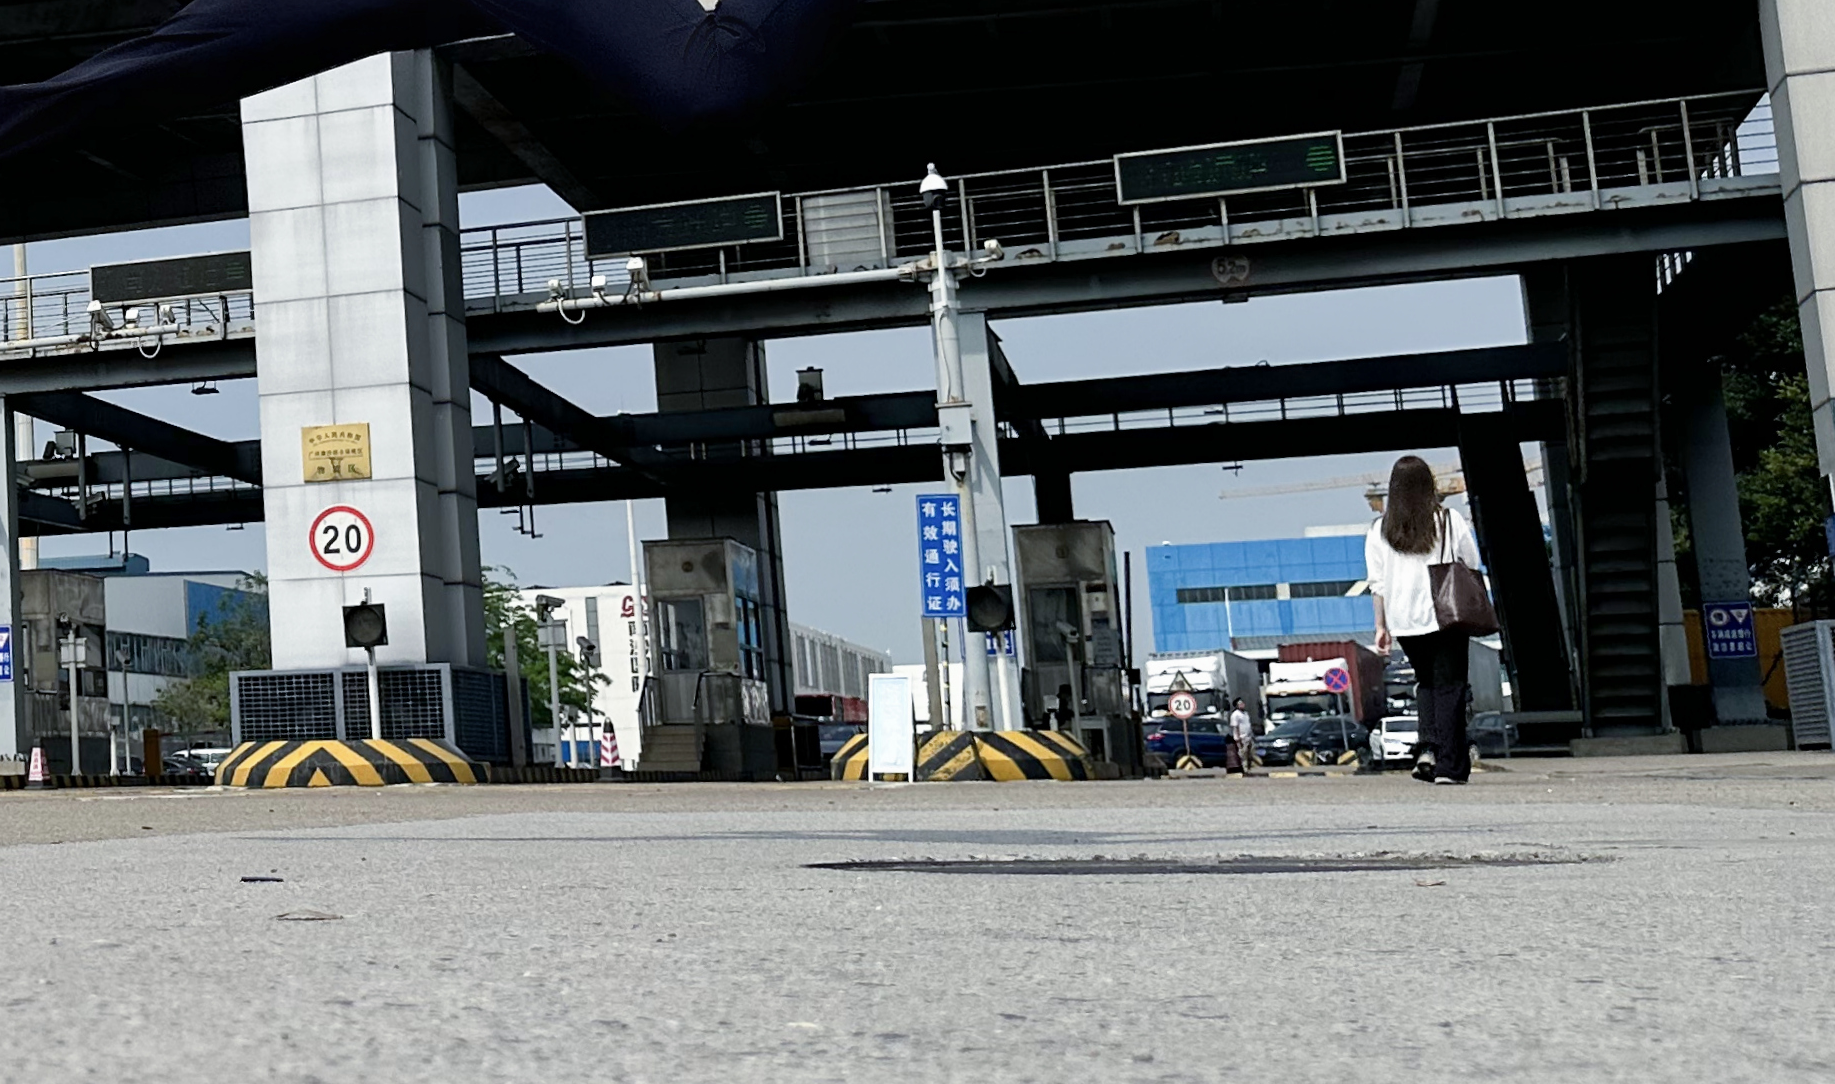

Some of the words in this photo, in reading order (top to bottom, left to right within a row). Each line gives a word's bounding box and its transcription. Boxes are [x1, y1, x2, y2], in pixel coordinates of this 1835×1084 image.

[322, 524, 362, 554] 20
[921, 502, 944, 611] 有效通行证
[940, 501, 962, 611] 长期驶入须办
[1174, 699, 1191, 711] 20
